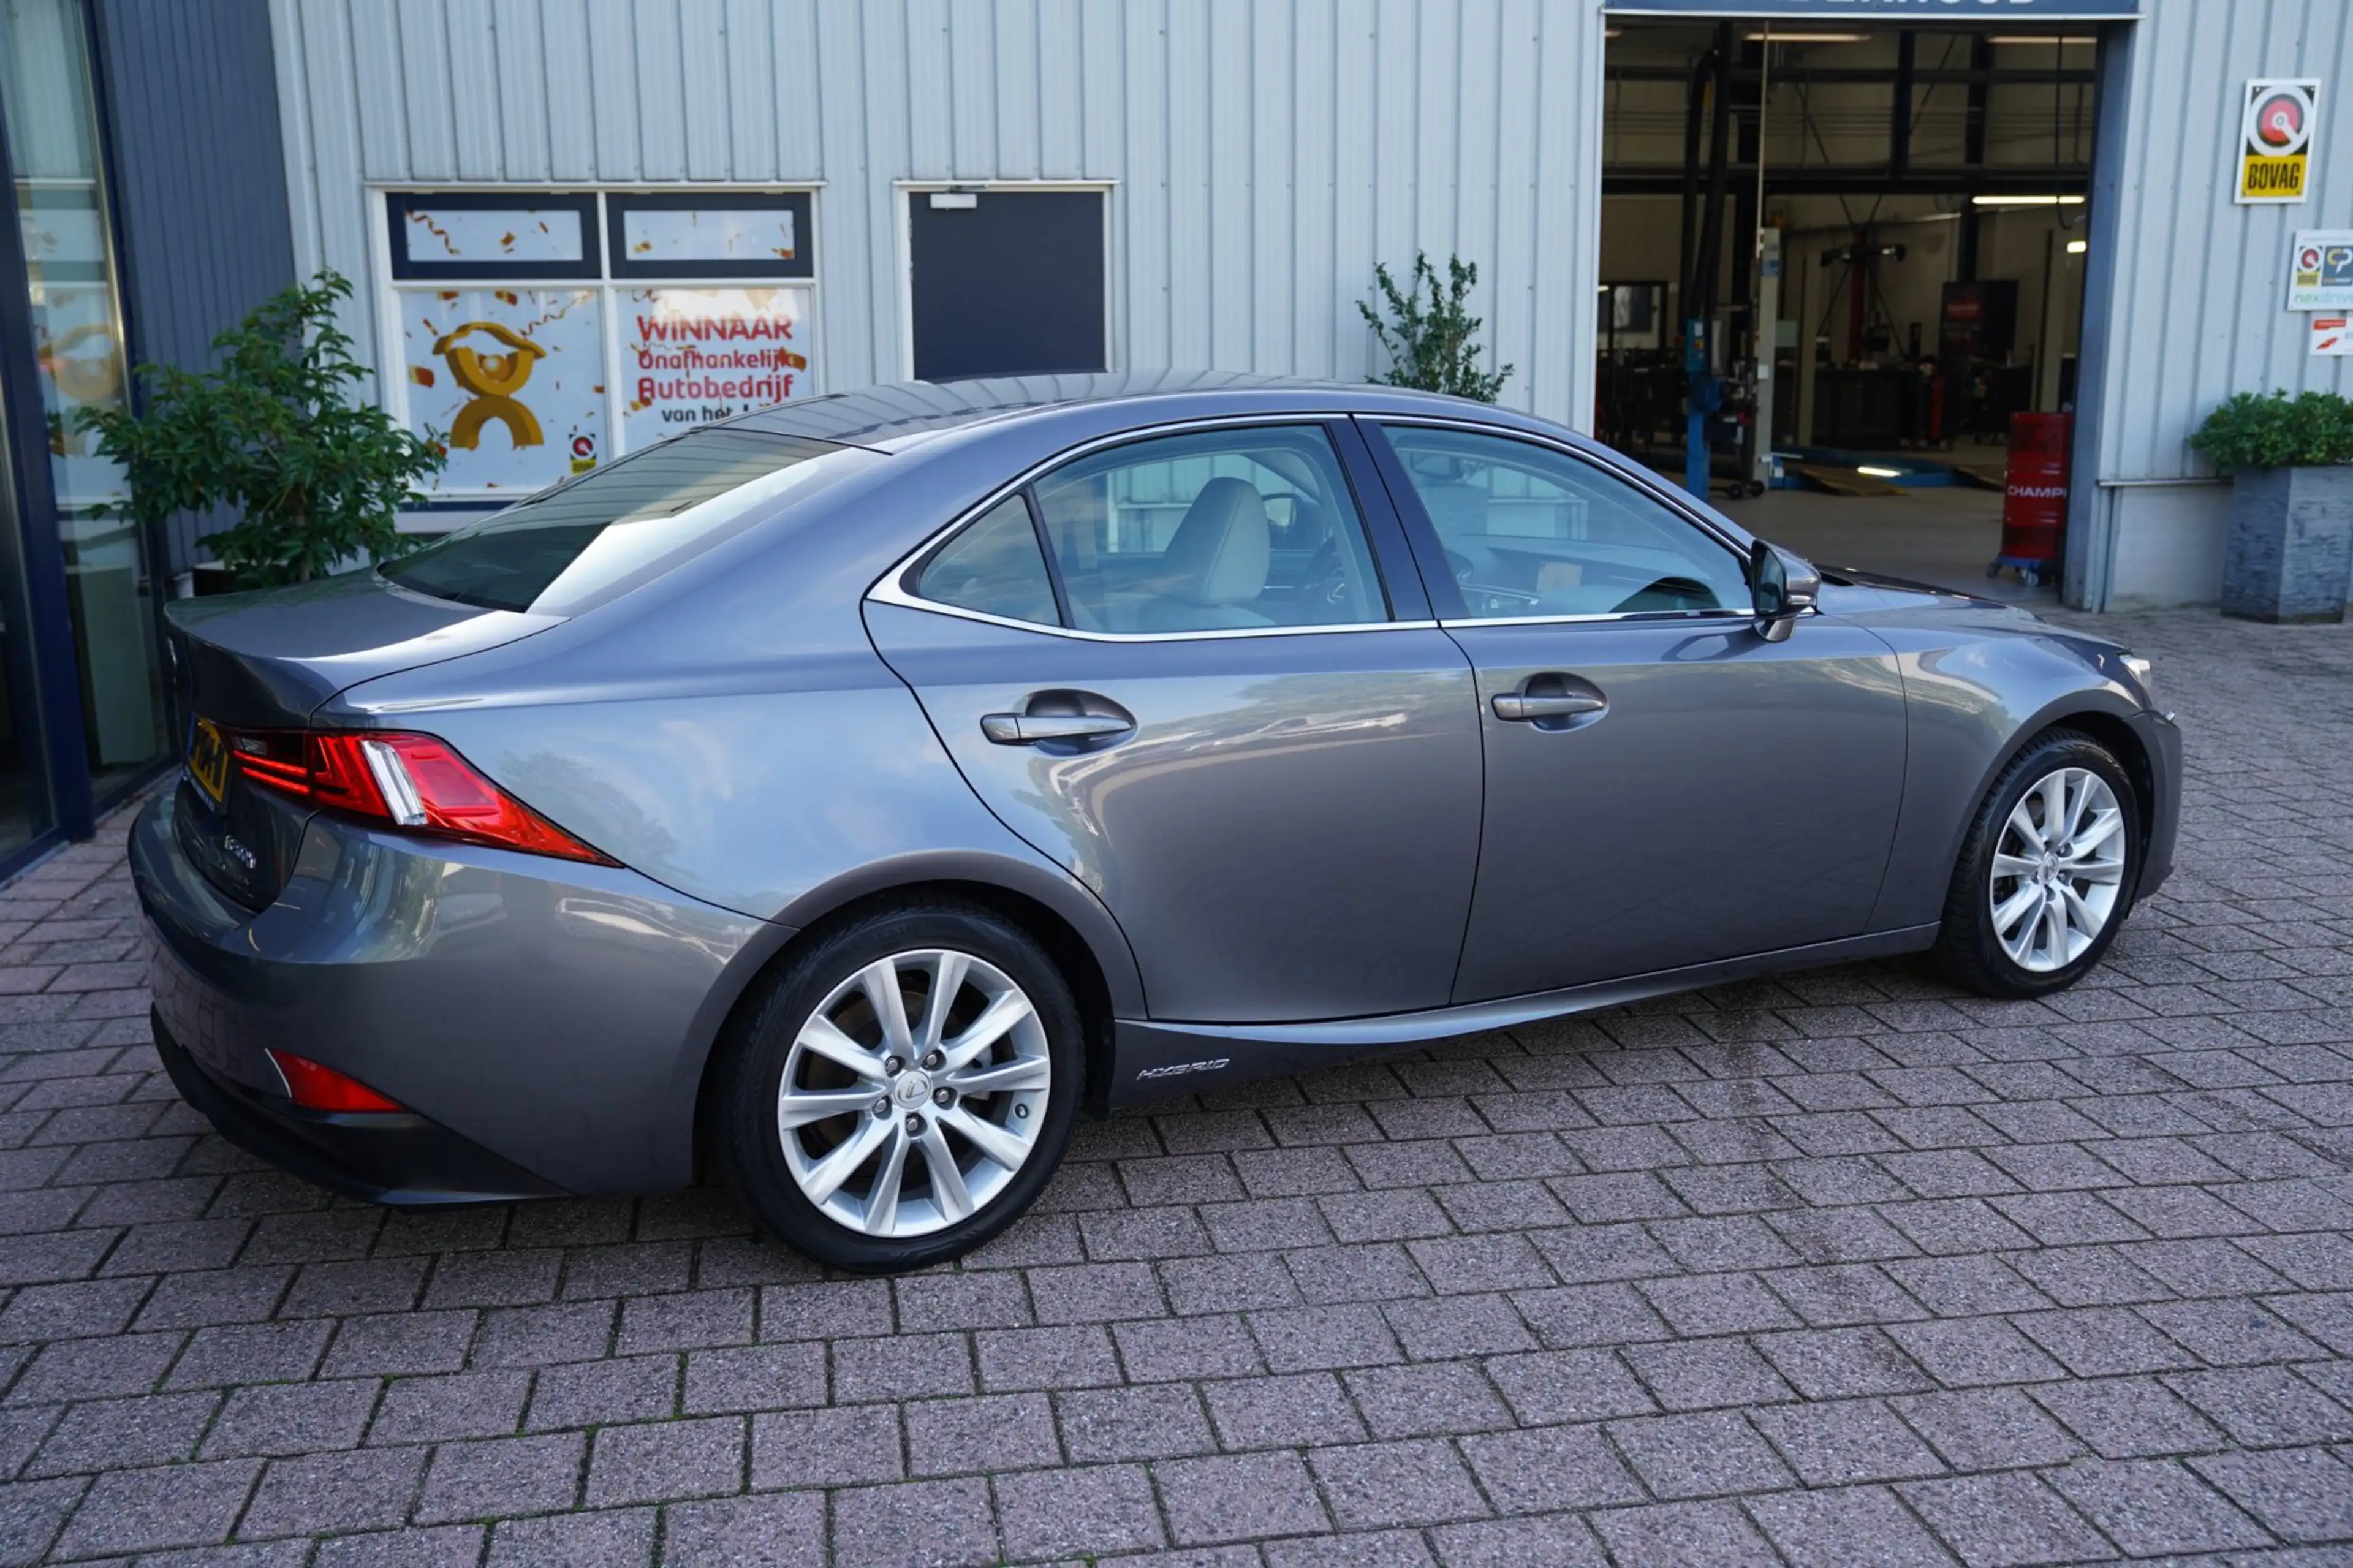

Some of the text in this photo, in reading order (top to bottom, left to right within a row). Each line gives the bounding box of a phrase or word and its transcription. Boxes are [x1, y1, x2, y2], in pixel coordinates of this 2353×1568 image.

[2248, 162, 2300, 190] BOVAG
[637, 314, 794, 341] WINNAAR
[638, 373, 794, 403] Autobedrijf
[662, 409, 696, 422] van
[702, 406, 732, 422] het
[1136, 1058, 1230, 1081] HYBRID
